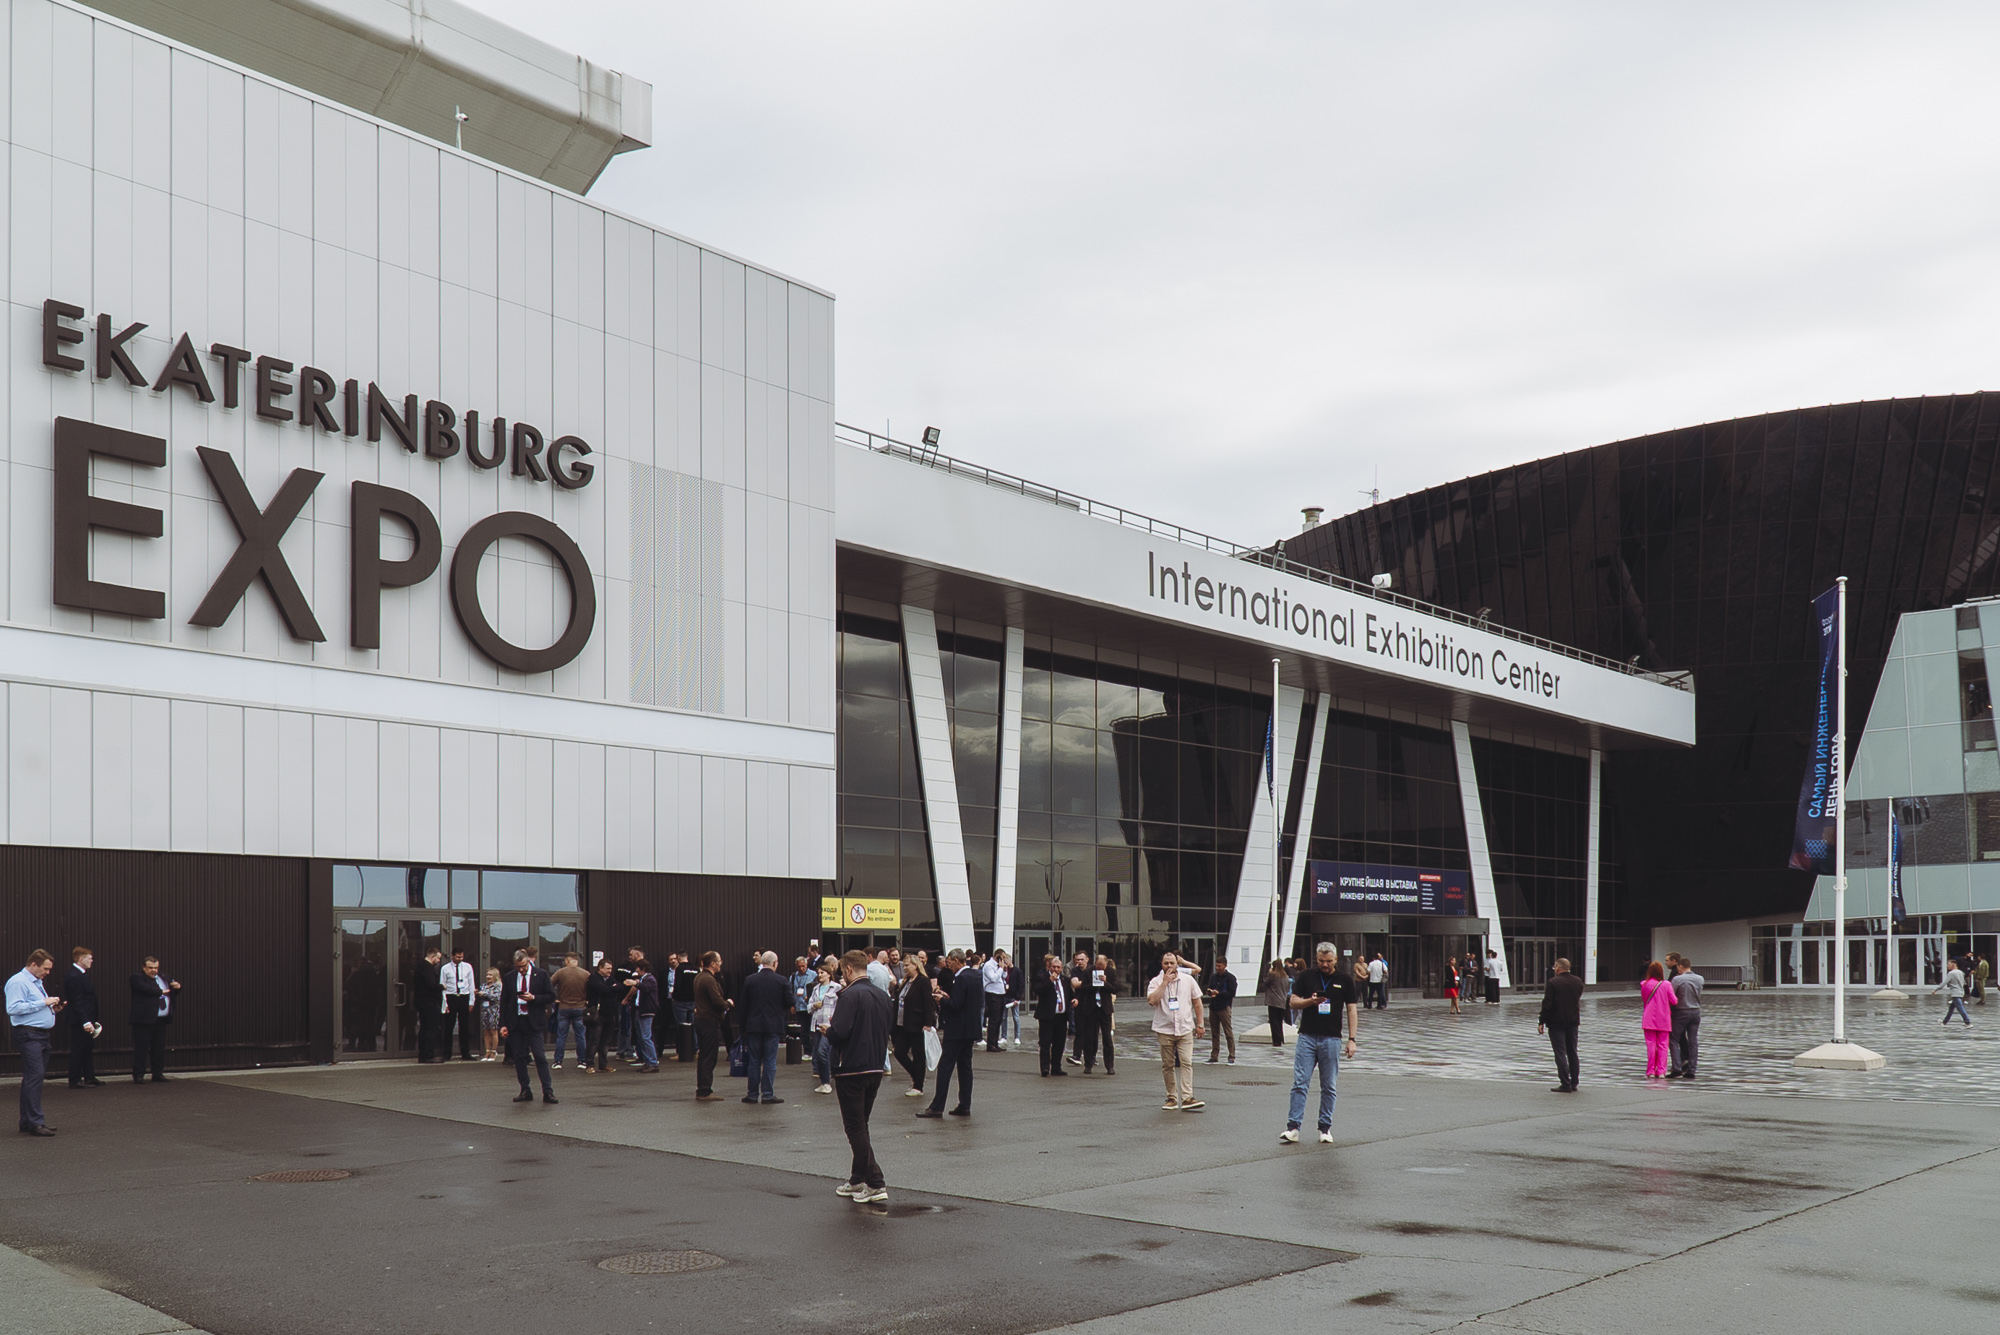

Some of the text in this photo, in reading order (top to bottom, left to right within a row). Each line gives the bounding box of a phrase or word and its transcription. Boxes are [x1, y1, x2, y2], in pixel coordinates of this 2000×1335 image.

[43, 298, 594, 490] EKATERINBURG
[53, 415, 596, 673] EXPO
[1148, 550, 1560, 699] International Exhibition Center
[1808, 762, 1827, 818] САМЫЙ
[867, 906, 878, 914] Нет
[1340, 875, 1418, 890] КРУПНЕЙШАЯ ВЫСТАВКА
[1340, 892, 1379, 901] ИНЖЕНЕРНОГО
[1379, 893, 1418, 903] ОБОРУДОВАНИЯ
